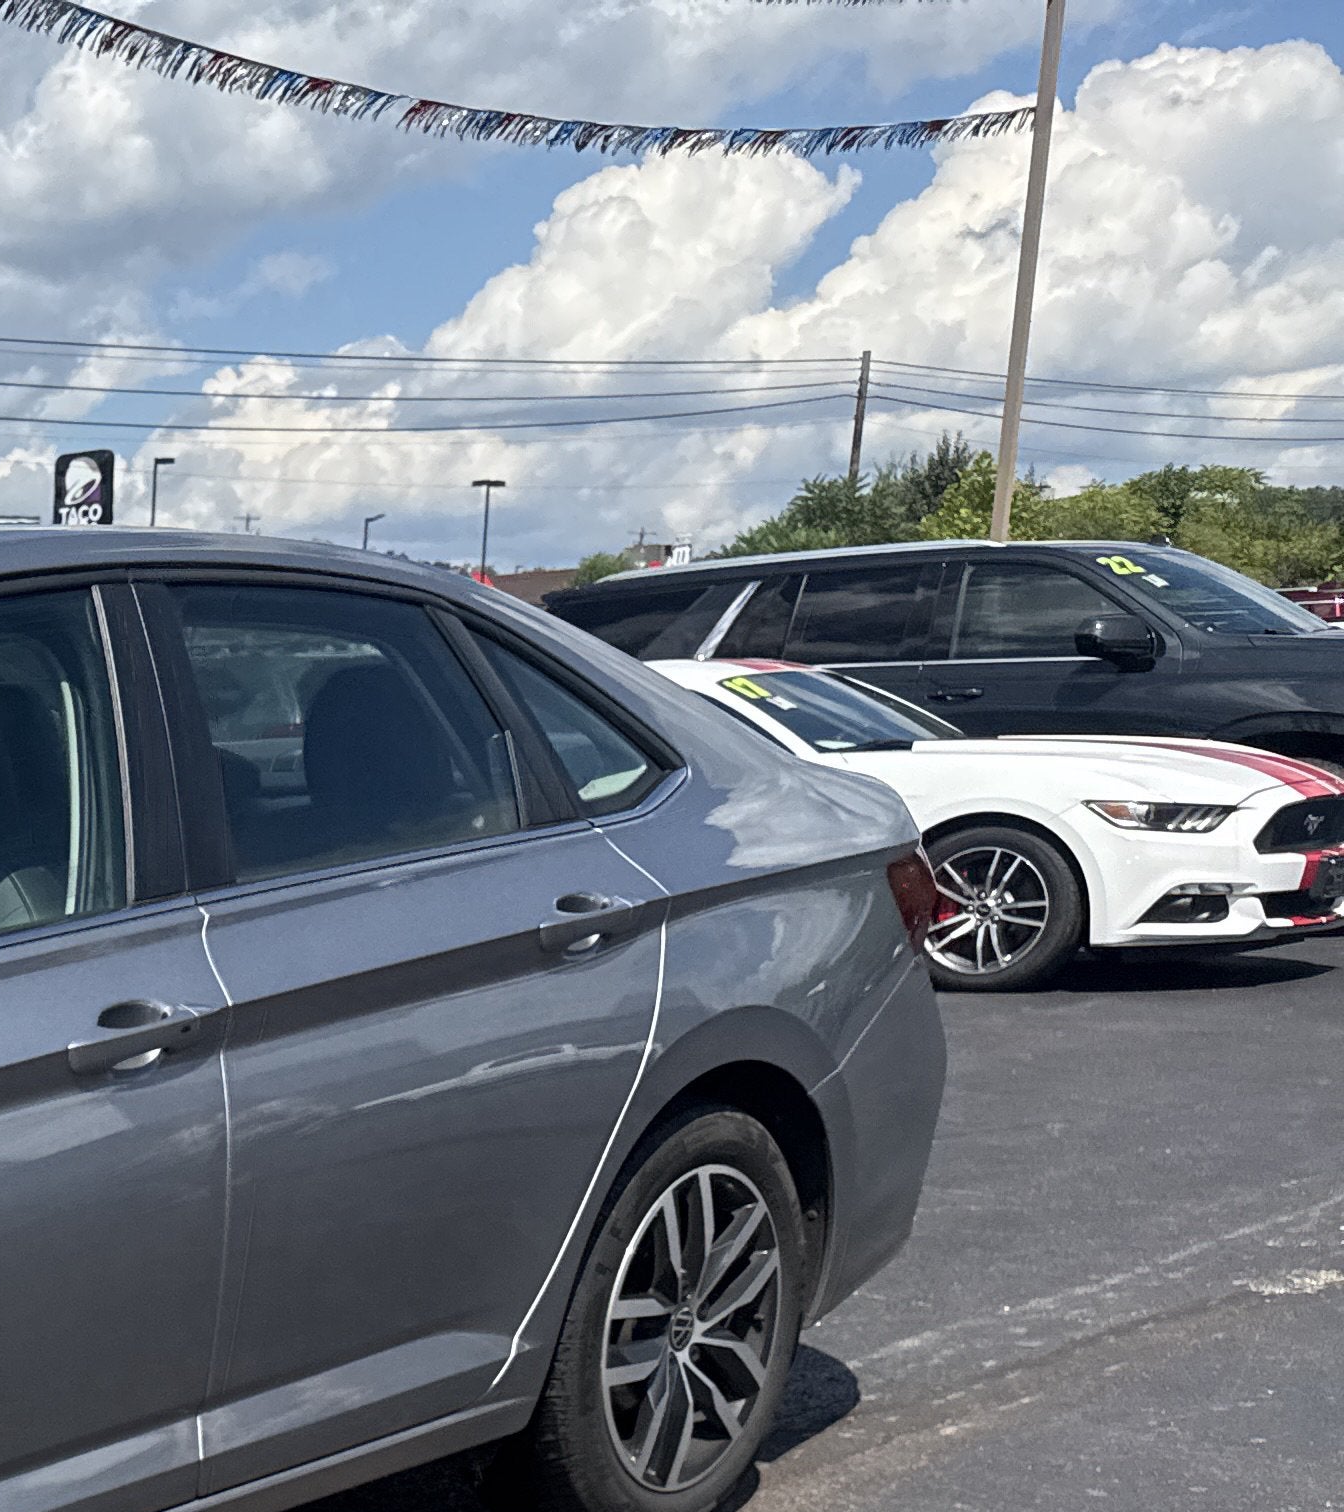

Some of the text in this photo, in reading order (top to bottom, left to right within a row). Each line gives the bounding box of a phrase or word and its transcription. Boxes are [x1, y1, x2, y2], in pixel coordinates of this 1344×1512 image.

[58, 503, 103, 526] TACO
[1095, 555, 1147, 575] 22
[721, 677, 773, 699] 17
